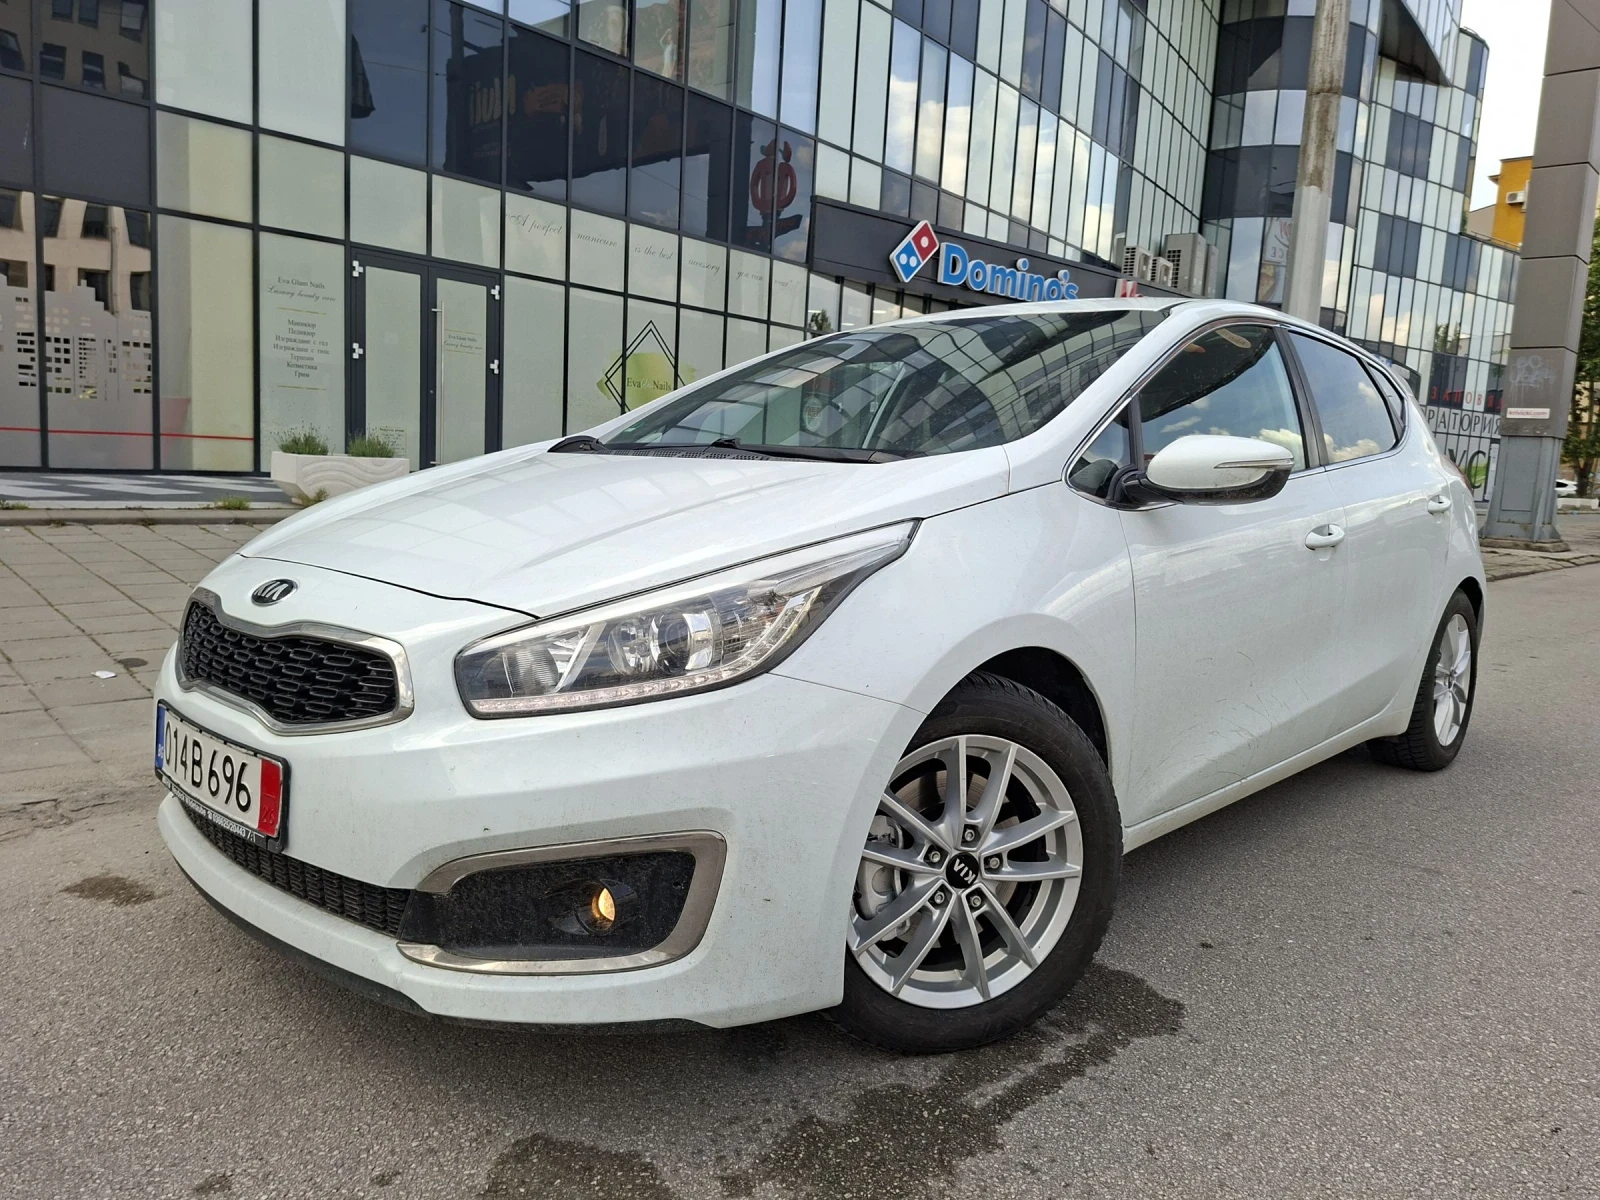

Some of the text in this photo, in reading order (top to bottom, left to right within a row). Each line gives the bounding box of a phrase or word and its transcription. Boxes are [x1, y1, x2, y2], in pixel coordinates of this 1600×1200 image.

[528, 218, 564, 237] perfect
[577, 233, 618, 247] manicure
[634, 244, 641, 253] is
[644, 245, 657, 256] the
[659, 247, 674, 260] best
[937, 242, 1079, 302] Domino's
[277, 276, 326, 290] Eva Glam Nails
[287, 319, 317, 330] Маникюр
[288, 327, 316, 338] Педикюр
[294, 370, 310, 379] Грим
[626, 377, 642, 389] Eva
[652, 380, 673, 392] Nails
[1421, 404, 1501, 435] РАТОРИЯ
[253, 580, 289, 601] KIA
[953, 858, 976, 884] KIA
